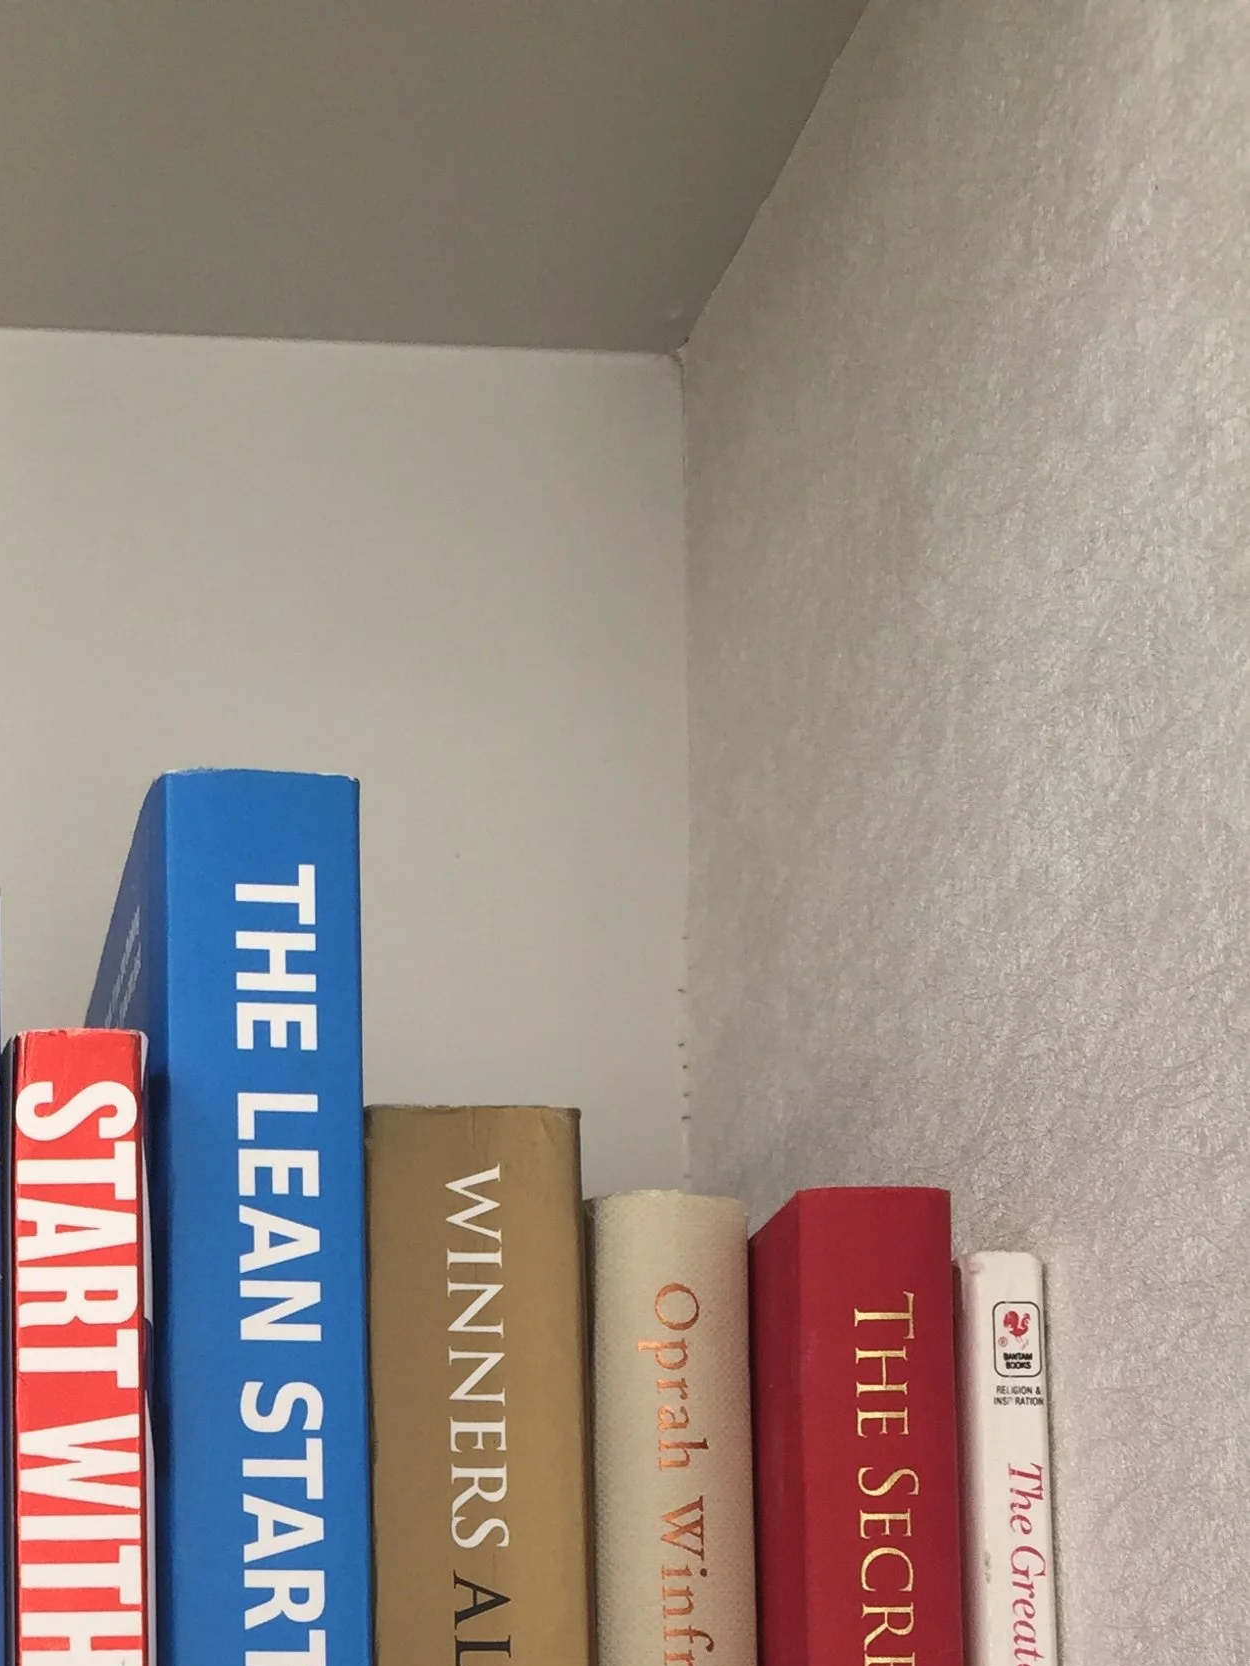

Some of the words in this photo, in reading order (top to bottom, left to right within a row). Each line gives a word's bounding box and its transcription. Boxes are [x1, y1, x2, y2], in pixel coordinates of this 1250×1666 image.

[234, 864, 318, 1051] THE
[14, 1080, 139, 1388] START
[237, 1091, 322, 1343] LEAN
[444, 1162, 510, 1550] WINNERS
[637, 1281, 710, 1472] Oprah
[853, 1291, 915, 1438] THE
[996, 1385, 1032, 1395] RELIGION
[1035, 1386, 1041, 1395] &
[1003, 1352, 1033, 1361] BANTAM
[1005, 1362, 1031, 1370] BOOKS
[1006, 1462, 1044, 1534] The
